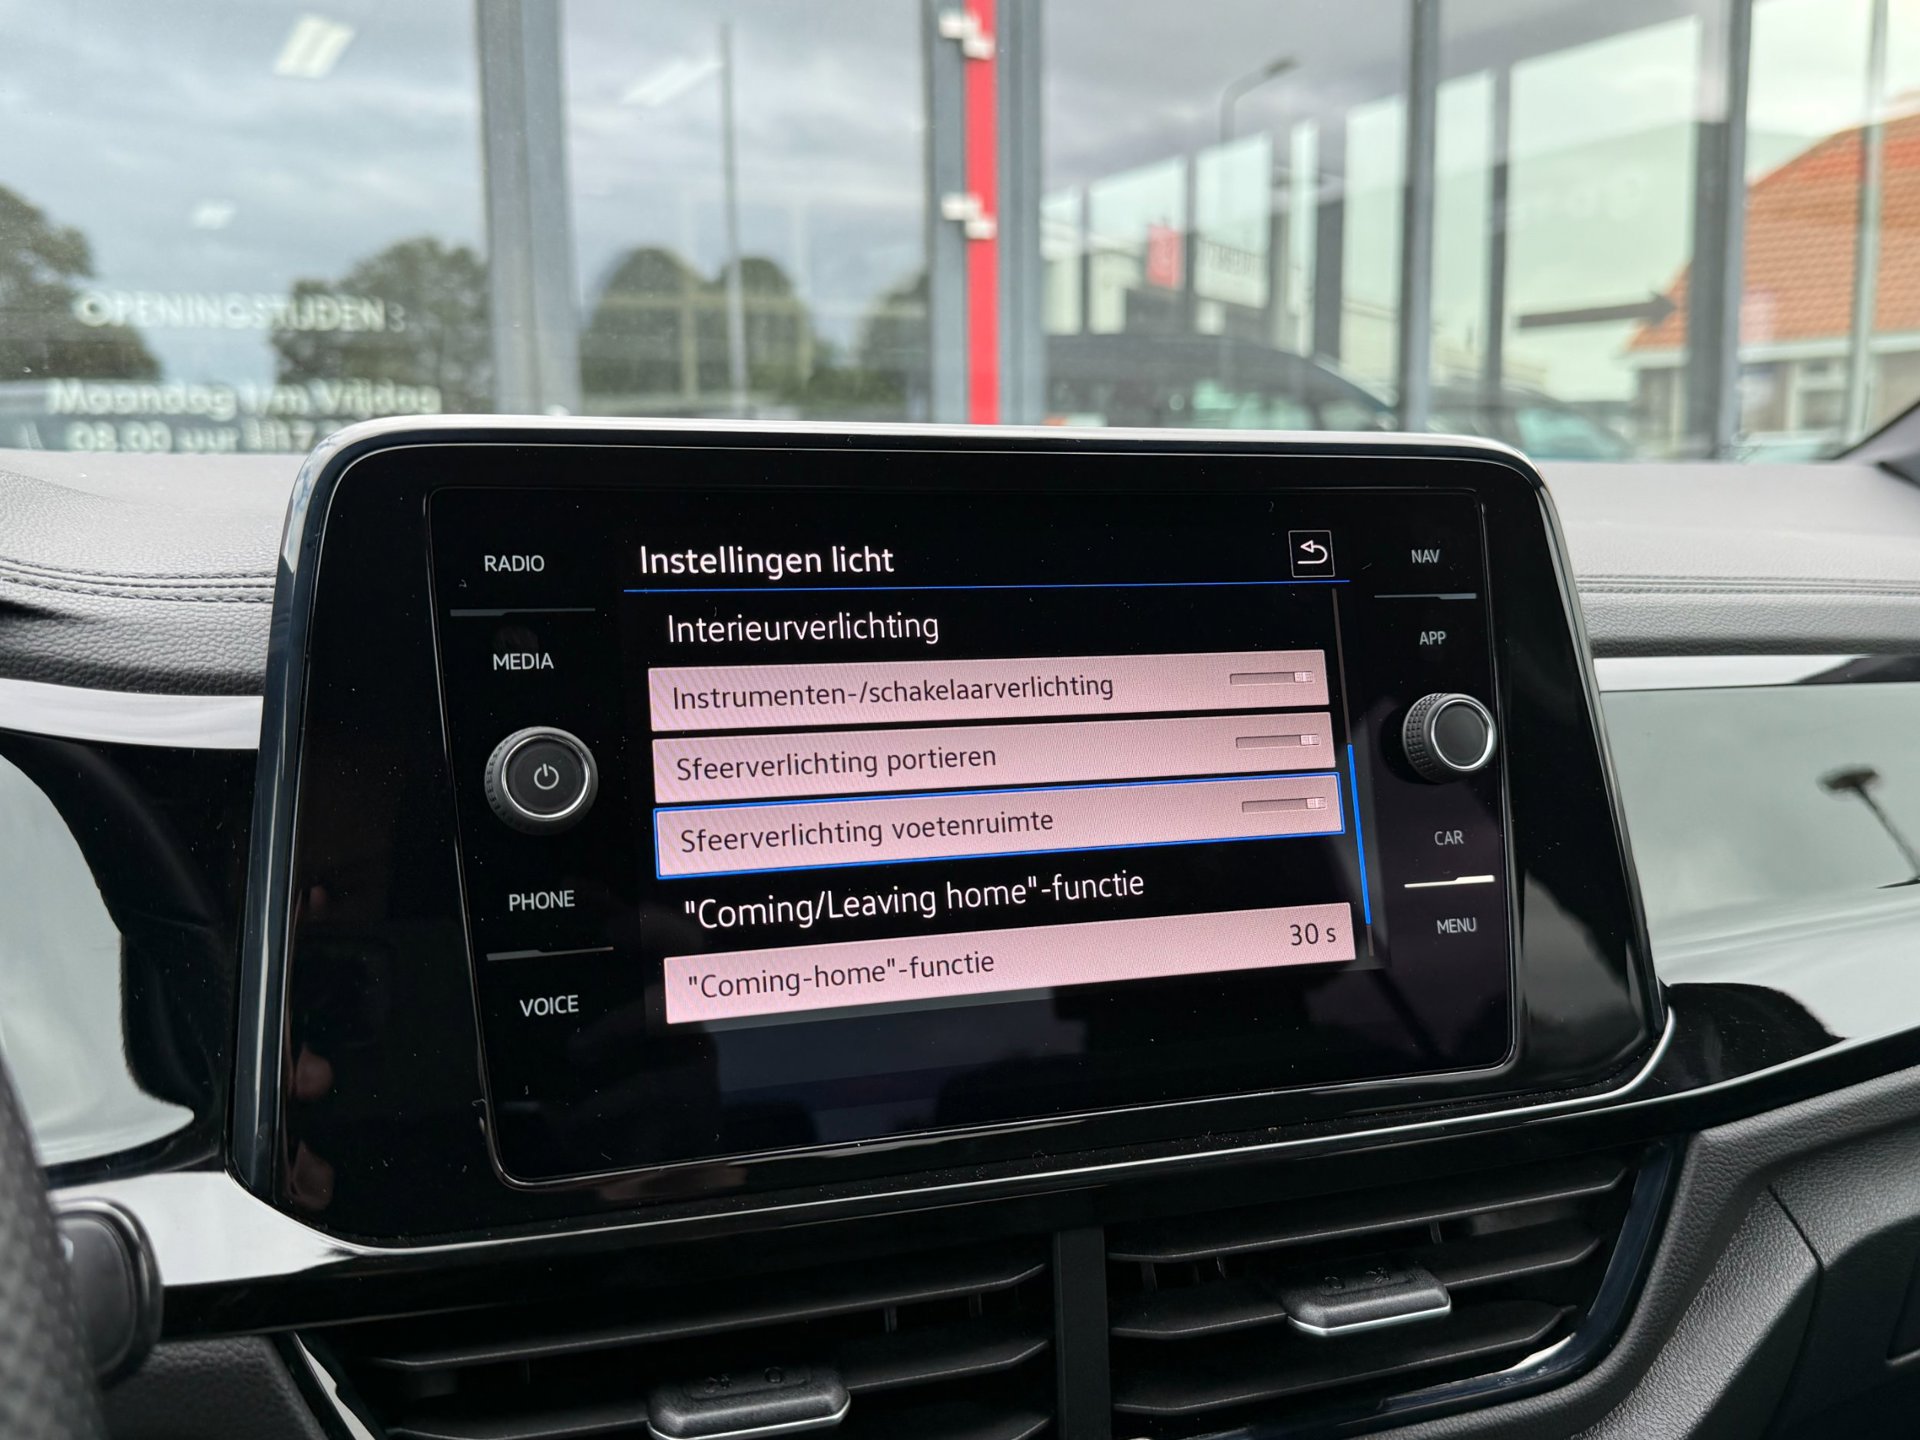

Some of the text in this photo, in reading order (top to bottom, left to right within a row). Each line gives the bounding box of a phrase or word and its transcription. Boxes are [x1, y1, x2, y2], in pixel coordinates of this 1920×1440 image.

[483, 554, 545, 573] RADIO
[639, 545, 895, 581] Instellingen licht
[1410, 549, 1441, 564] NAV
[667, 612, 940, 646] Interieurverlichting
[1419, 630, 1447, 646] APP
[492, 652, 555, 671] MEDIA
[672, 673, 1115, 711] Instrumenten-/schakelaarverlichting
[676, 747, 997, 782] Sfeerverlichting portieren
[680, 809, 1054, 854] Sfeerverlichting voetenruimte
[1433, 829, 1465, 847] CAR
[508, 889, 577, 912] PHONE
[684, 869, 1145, 930] "Coming/Leaving home"-functie
[1289, 922, 1337, 947] 30 s
[1435, 916, 1478, 935] MENU
[687, 950, 996, 1000] "Coming-home"-functie
[518, 994, 580, 1017] VOICE
